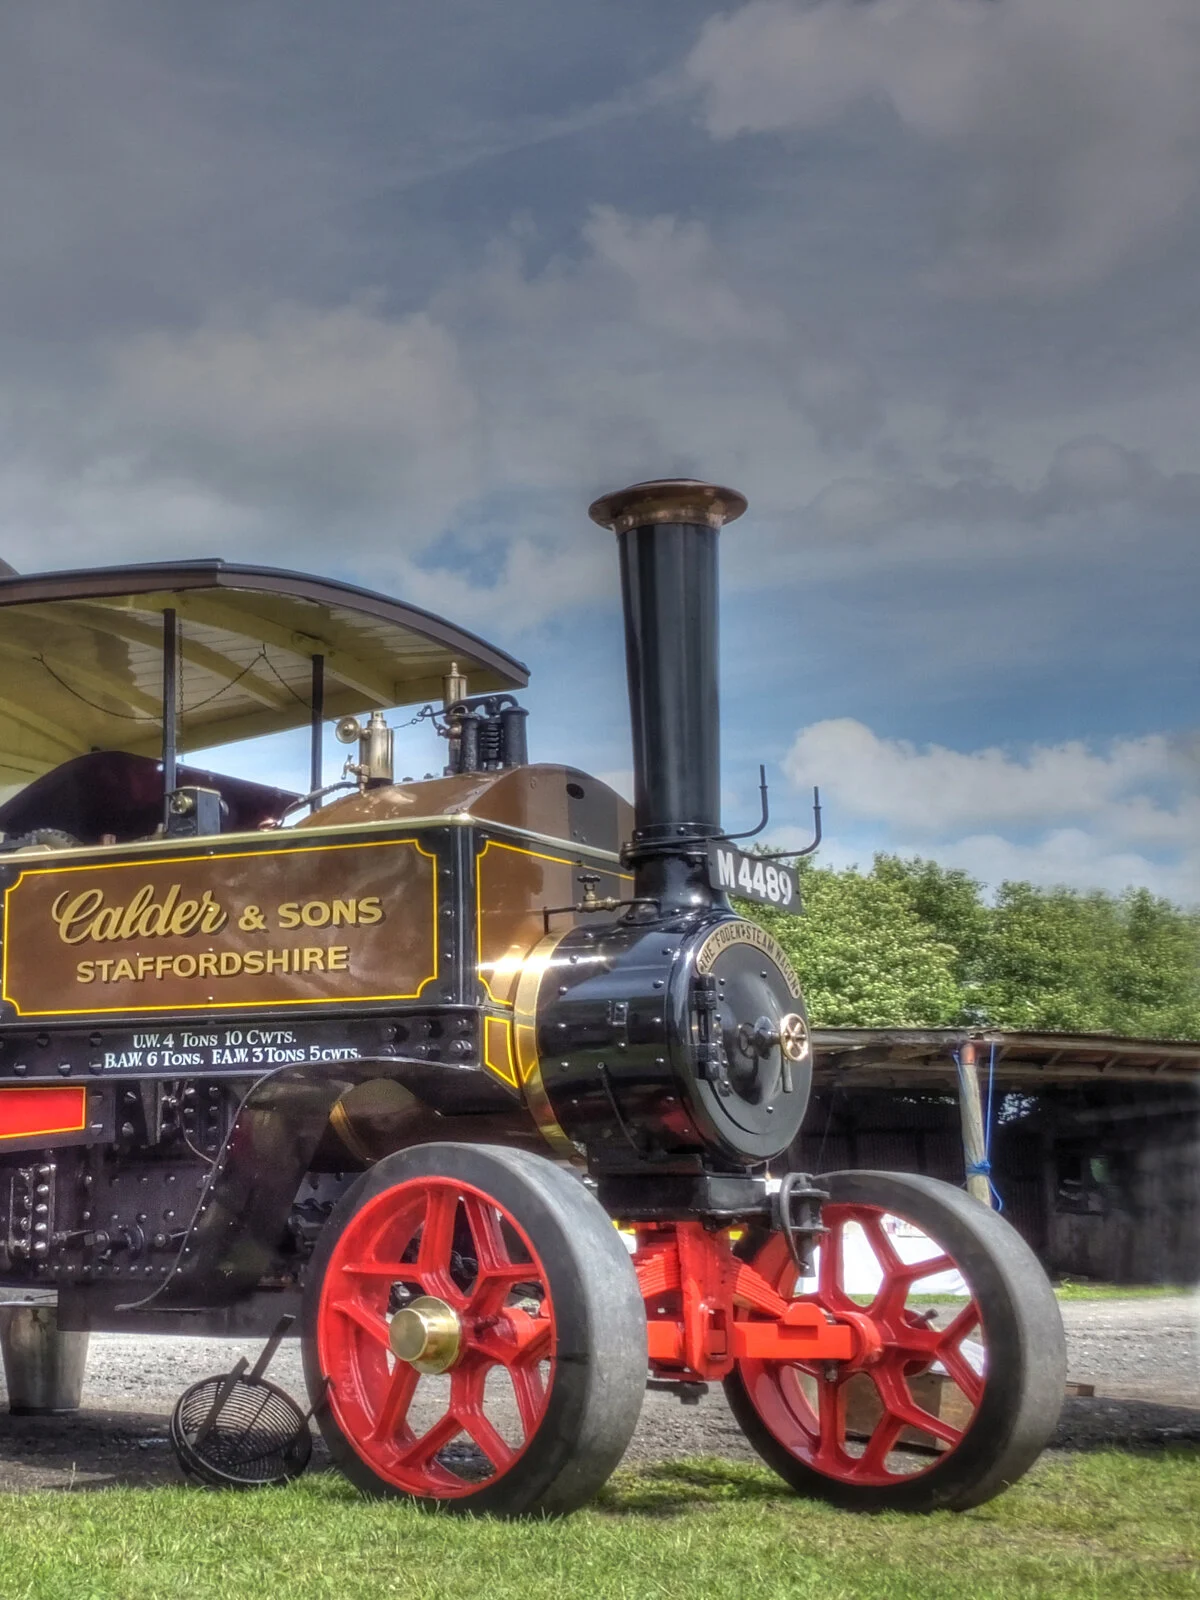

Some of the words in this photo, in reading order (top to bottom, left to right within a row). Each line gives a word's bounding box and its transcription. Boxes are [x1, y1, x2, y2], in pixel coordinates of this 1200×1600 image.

[52, 884, 227, 944] Calder
[239, 905, 266, 931] &
[278, 897, 383, 928] SONS
[76, 946, 350, 984] STAFFORDSHIRE
[701, 944, 715, 968] THE
[746, 925, 775, 954] STEAM
[133, 1033, 160, 1048] U.W.
[163, 1033, 175, 1048] 4
[225, 1030, 242, 1046] 10
[146, 1051, 157, 1066] 6
